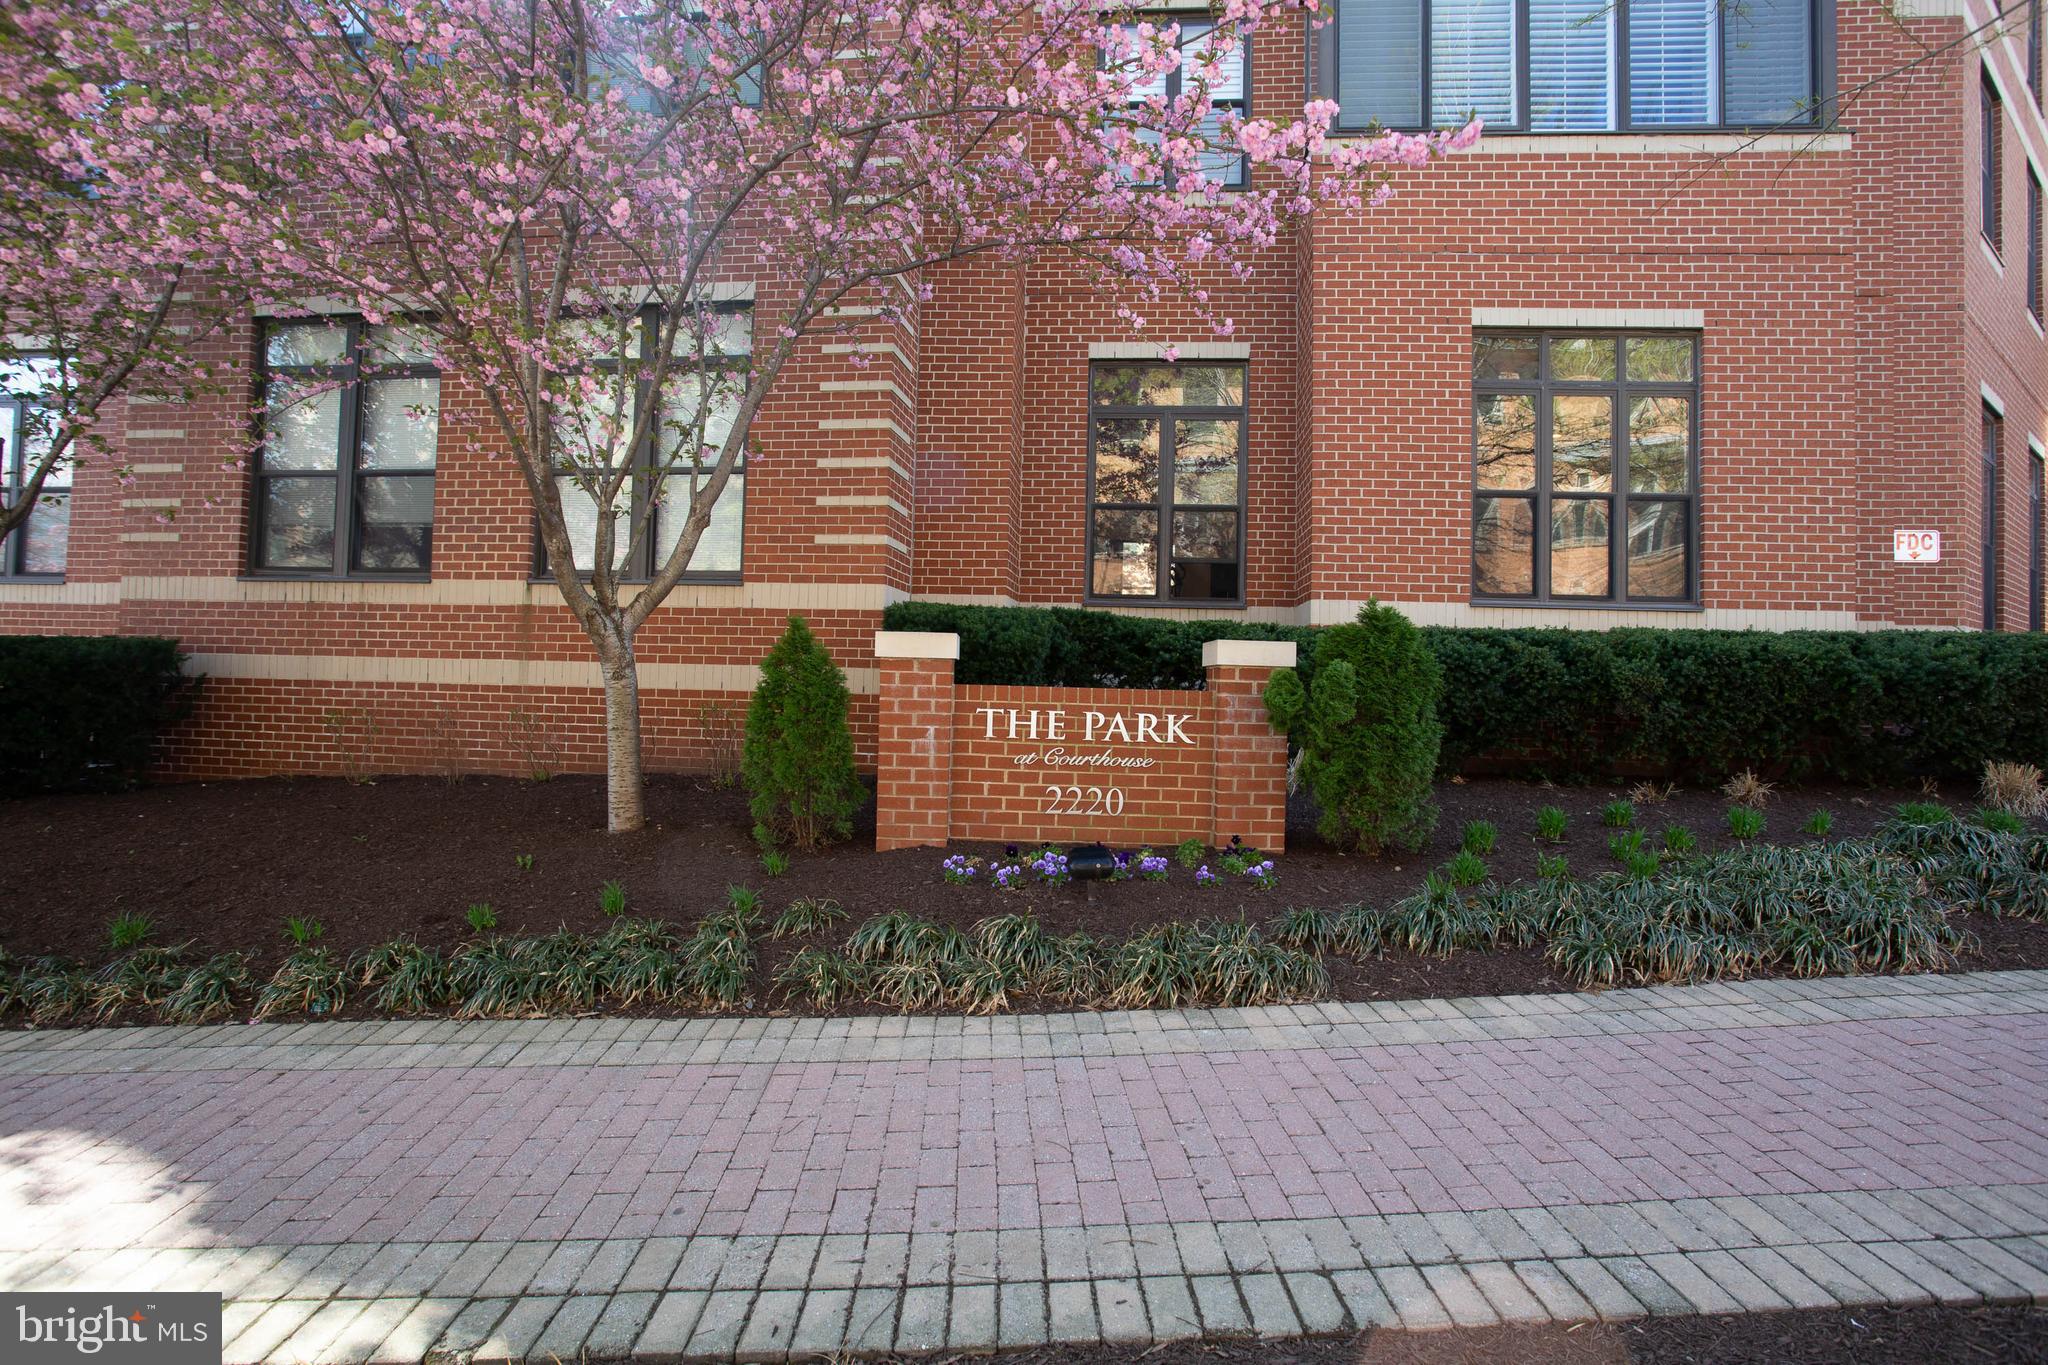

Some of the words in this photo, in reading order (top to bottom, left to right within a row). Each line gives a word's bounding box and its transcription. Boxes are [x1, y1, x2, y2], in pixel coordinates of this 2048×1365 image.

[1896, 533, 1933, 551] FDC
[976, 708, 1066, 741] THE
[1082, 711, 1196, 744] PARK
[1013, 751, 1038, 765] at
[1043, 747, 1156, 768] Courthouse
[1044, 786, 1124, 816] 2220
